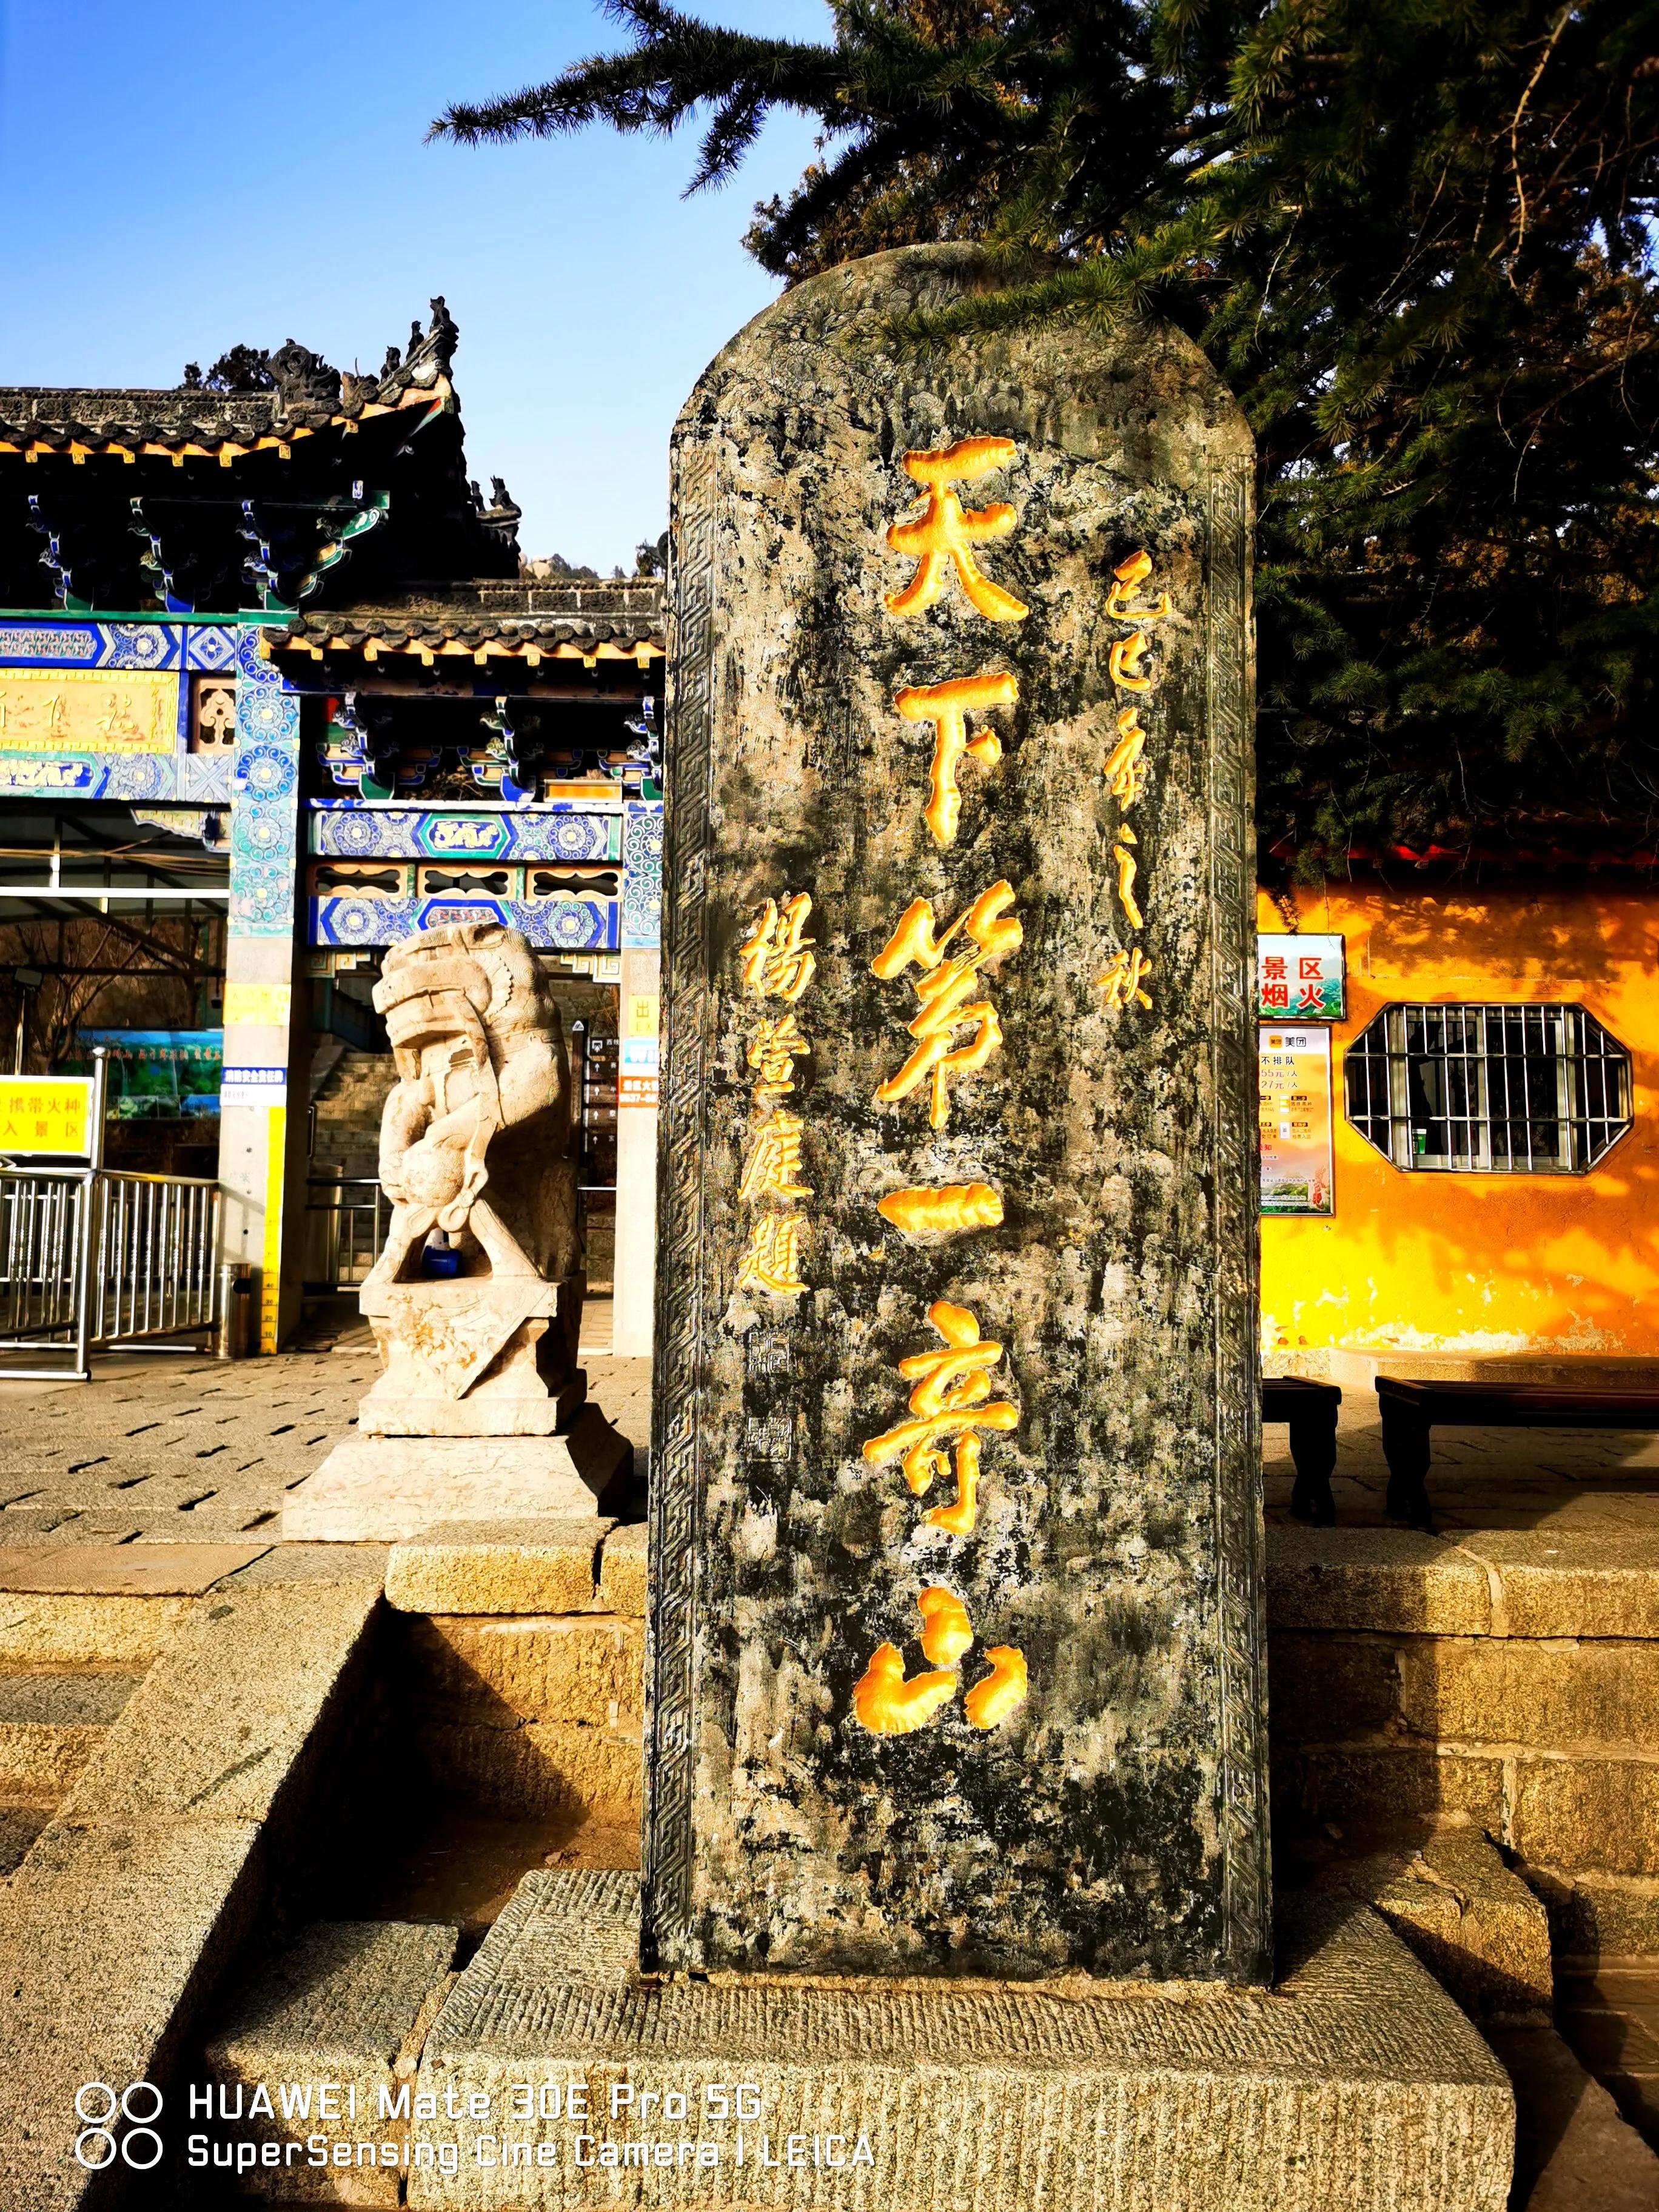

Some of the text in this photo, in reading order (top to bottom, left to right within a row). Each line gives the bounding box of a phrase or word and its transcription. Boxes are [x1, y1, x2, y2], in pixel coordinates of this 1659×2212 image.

[1261, 956, 1324, 980] 景区
[1261, 983, 1325, 1009] 烟火
[1285, 1037, 1306, 1047] 美团
[1261, 1056, 1295, 1065] 不排队
[853, 435, 1030, 1736] 天下第一奇山
[0, 1096, 80, 1114] 携带火种
